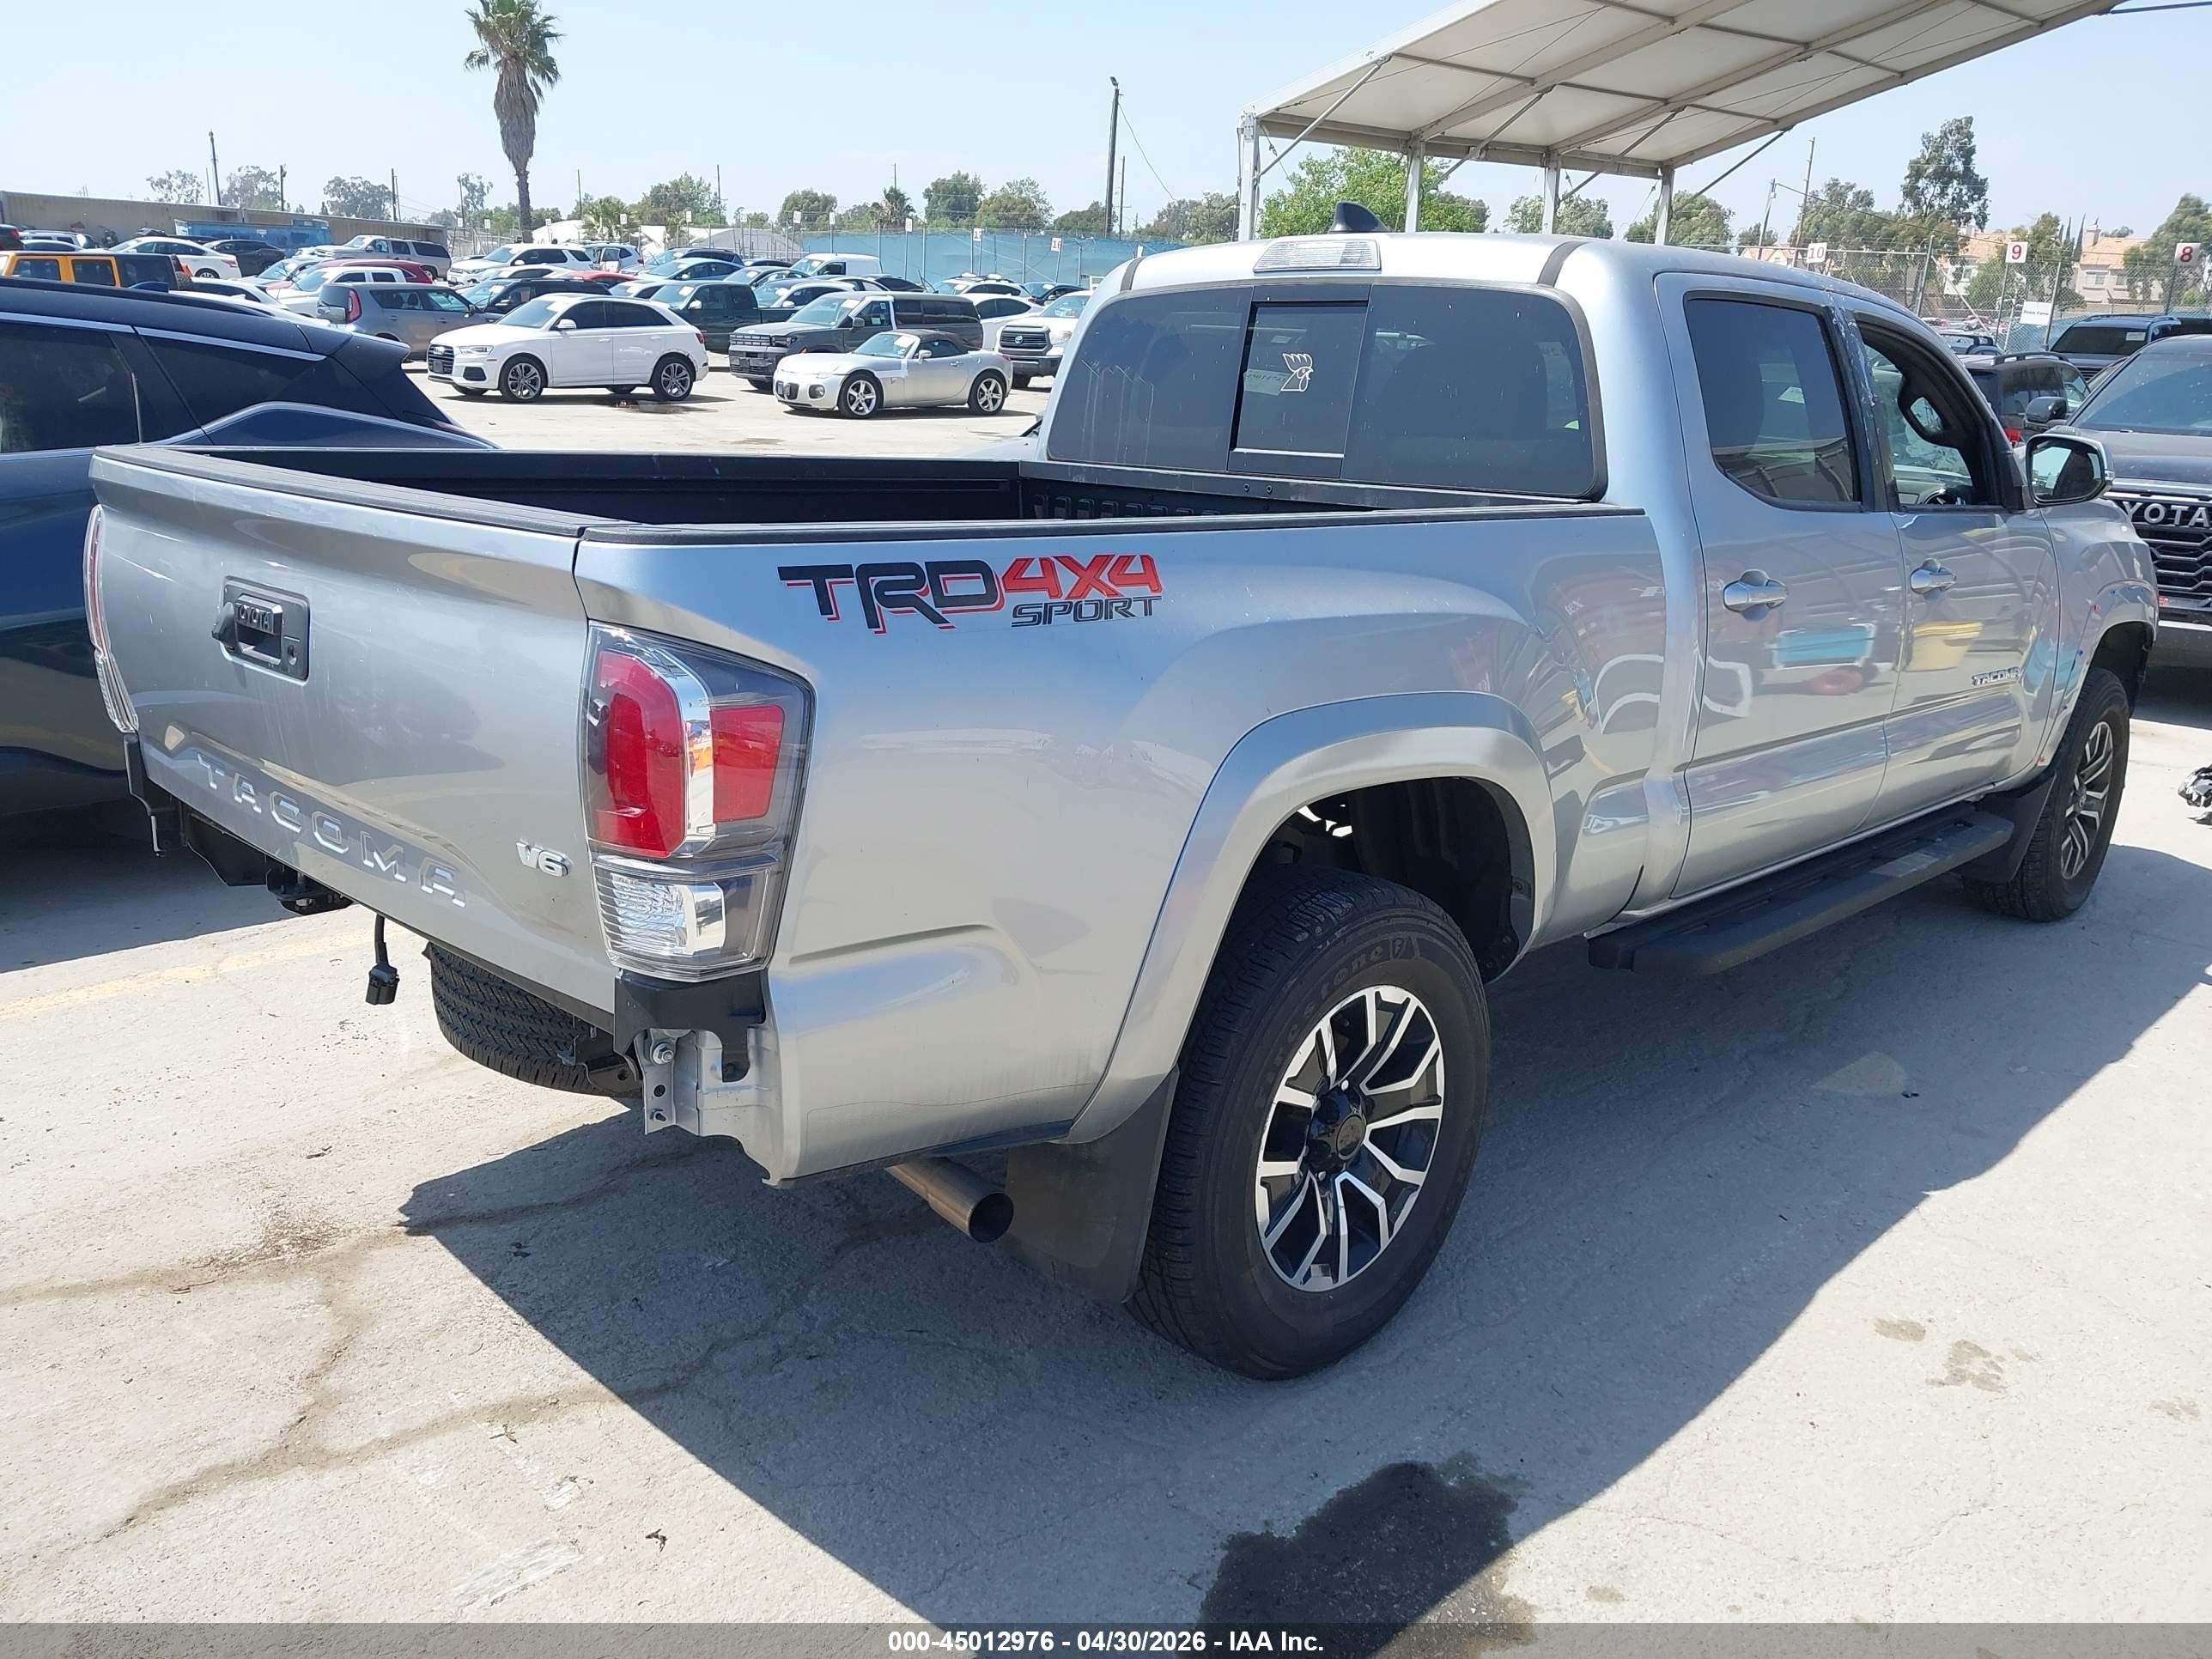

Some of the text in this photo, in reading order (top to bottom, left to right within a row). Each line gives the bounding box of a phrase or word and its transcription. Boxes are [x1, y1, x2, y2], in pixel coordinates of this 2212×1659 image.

[1053, 240, 1063, 249] 16
[1808, 246, 1825, 259] 10
[2011, 244, 2022, 260] 9
[2179, 246, 2193, 263] 8
[777, 559, 1006, 635] TRD
[1010, 595, 1163, 628] SPORT
[1972, 666, 2021, 685] TACOMA
[197, 752, 467, 908] TACOMA
[515, 839, 574, 878] V6
